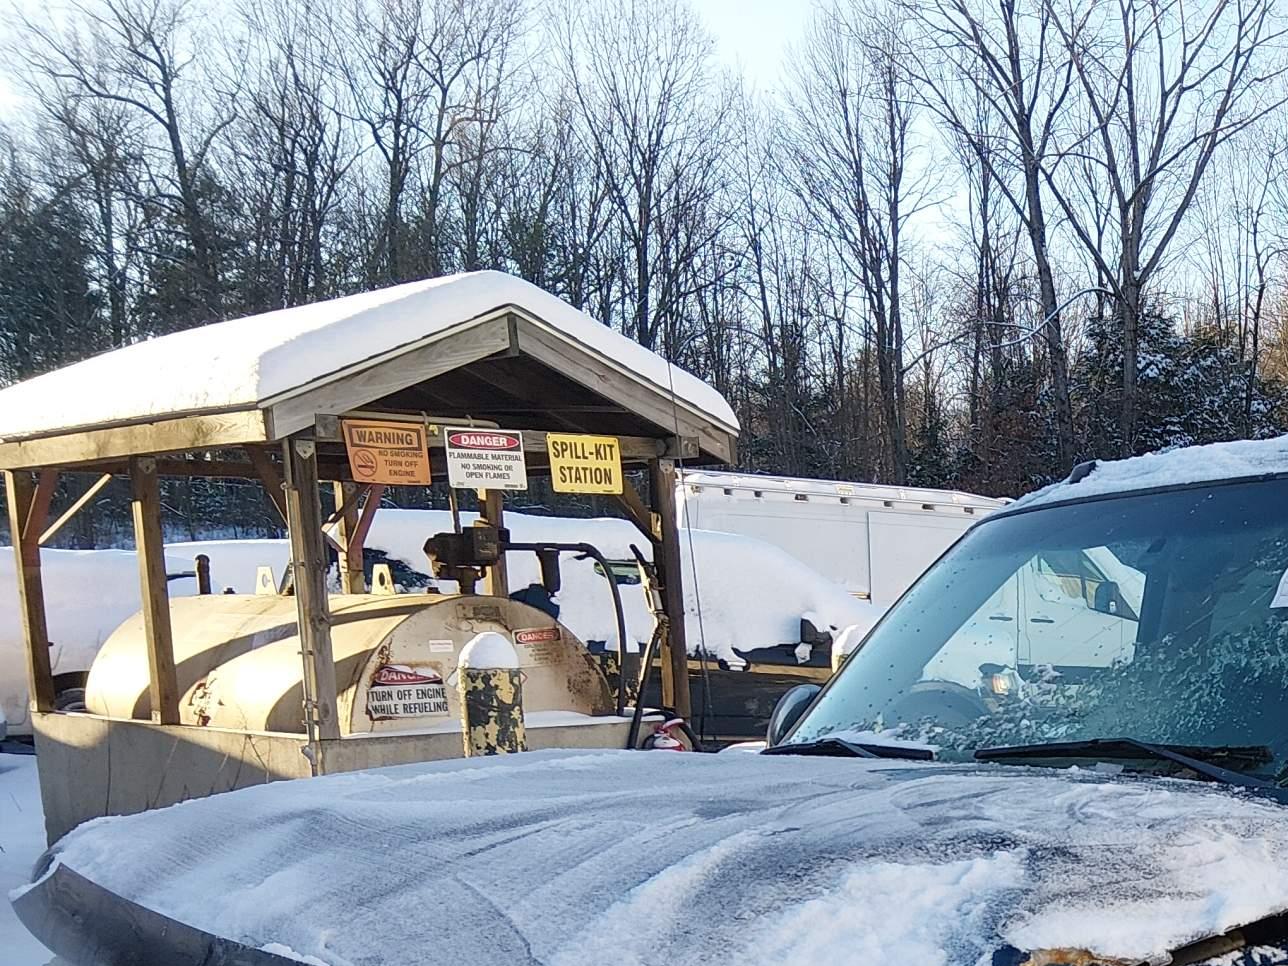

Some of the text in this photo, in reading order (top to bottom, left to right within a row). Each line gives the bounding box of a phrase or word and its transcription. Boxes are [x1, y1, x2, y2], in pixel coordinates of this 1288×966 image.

[356, 430, 414, 446] WARNING
[461, 435, 508, 447] DANGER
[390, 450, 424, 458] SMOKING
[448, 451, 522, 461] FLAMMABLE MATERIAL
[552, 440, 615, 461] SPILL-KIT
[404, 460, 419, 468] OFF
[472, 463, 503, 471] SMOKING
[504, 464, 513, 472] OR
[388, 469, 416, 477] ENGINE
[465, 471, 511, 480] OPEN FLAMES
[559, 465, 613, 485] STATION
[371, 687, 448, 702] TURN OFF ENGINE
[371, 701, 449, 715] WHILE REFUELING
